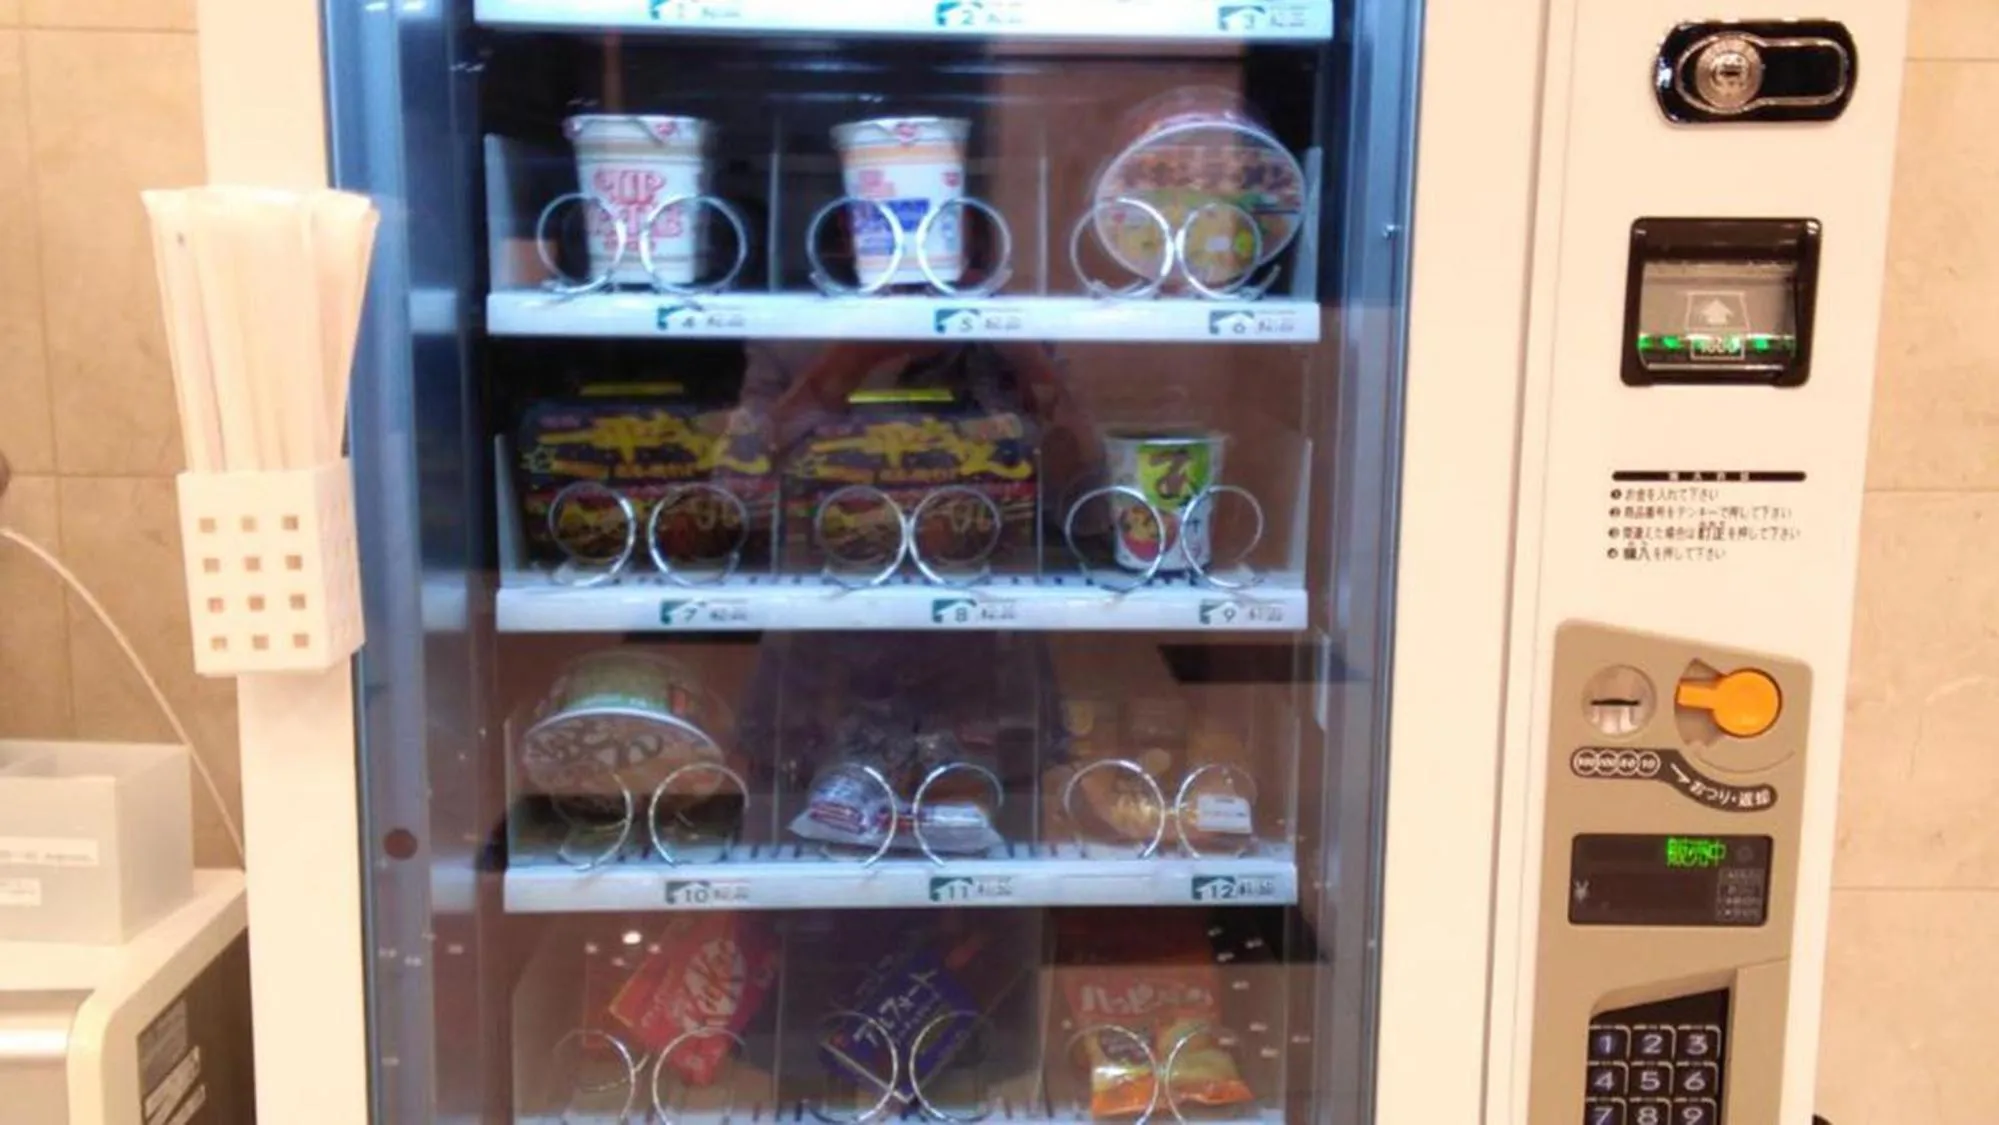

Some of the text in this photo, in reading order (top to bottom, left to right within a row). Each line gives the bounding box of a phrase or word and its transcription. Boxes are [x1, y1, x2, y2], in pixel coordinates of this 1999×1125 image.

[1233, 319, 1247, 335] 6
[1625, 488, 1719, 501] お金を入れて下さい
[1223, 606, 1237, 623] 9
[685, 887, 709, 904] 10
[949, 884, 969, 900] 11
[1211, 883, 1235, 900] 12
[1600, 1034, 1708, 1055] 1 2 3
[1594, 1070, 1706, 1091] 4 5 6
[1593, 1106, 1703, 1125] 7 8 9
